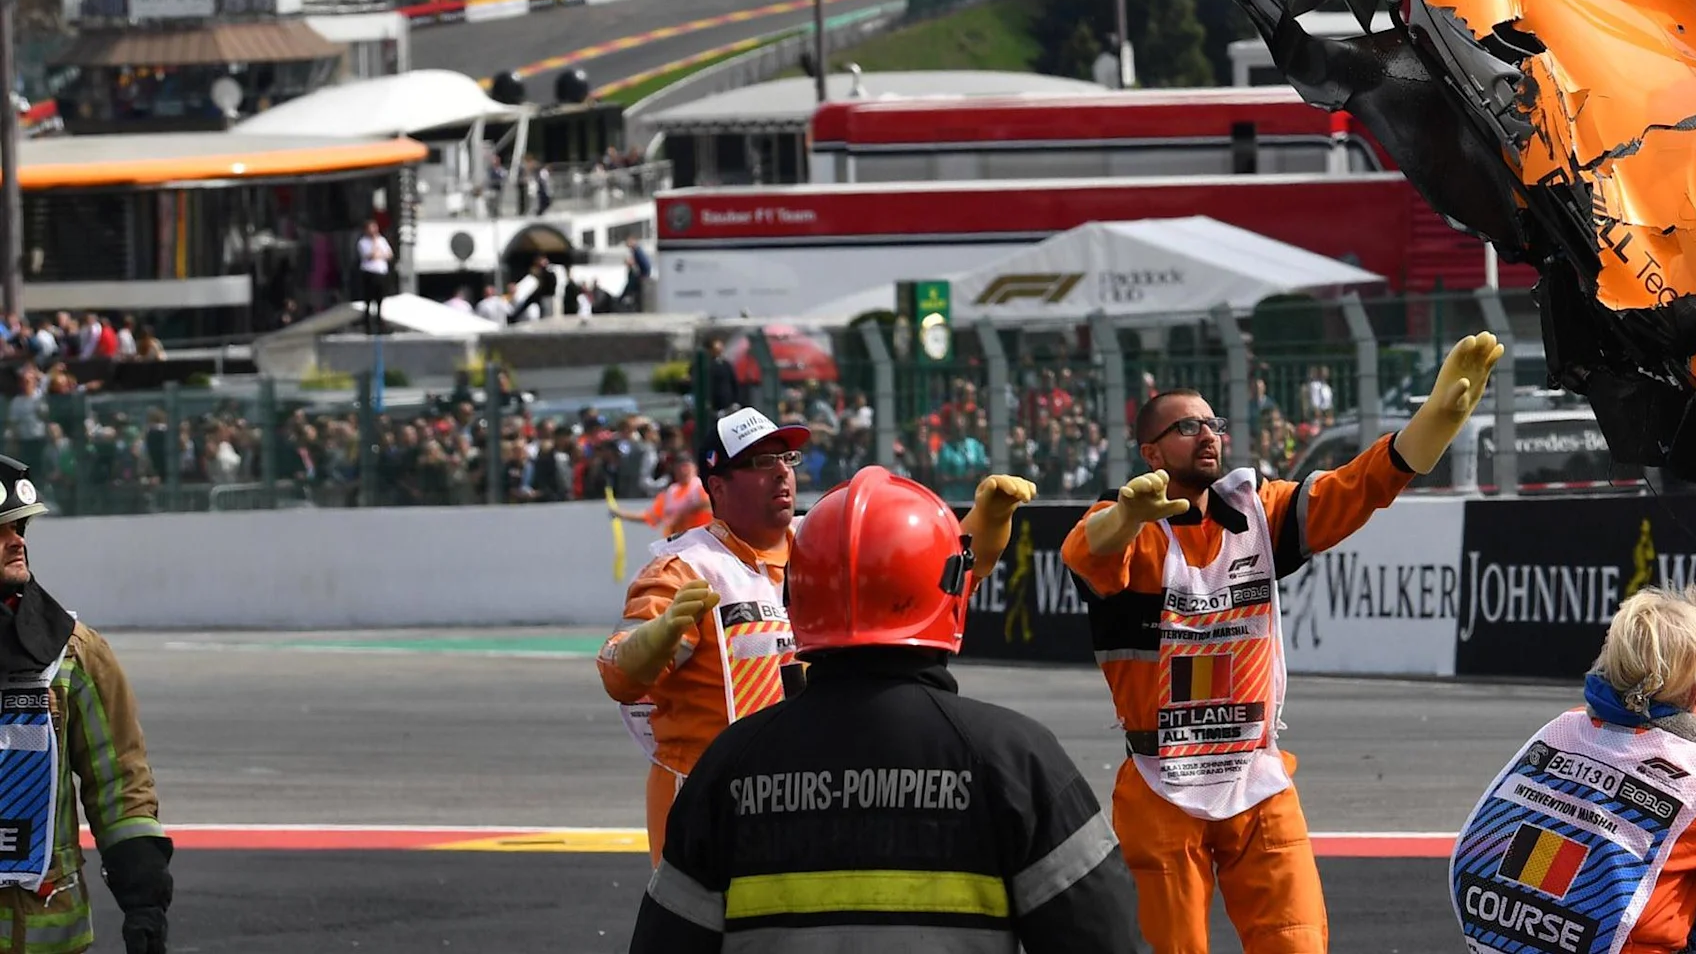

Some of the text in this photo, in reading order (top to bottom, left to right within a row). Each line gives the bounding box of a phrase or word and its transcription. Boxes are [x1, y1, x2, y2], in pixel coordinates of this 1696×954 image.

[1324, 551, 1458, 620] WALKER
[1460, 550, 1620, 641] JOHNNIE
[1158, 705, 1248, 727] PIT LANE
[1162, 727, 1242, 744] ALL TIMES
[730, 768, 972, 816] SAPEURS-POMPIERS
[1549, 753, 1616, 792] BEL1130
[1514, 783, 1619, 835] INTERVENTION MARSHAL
[1619, 782, 1674, 819] 2018
[1465, 885, 1586, 953] COURSE
